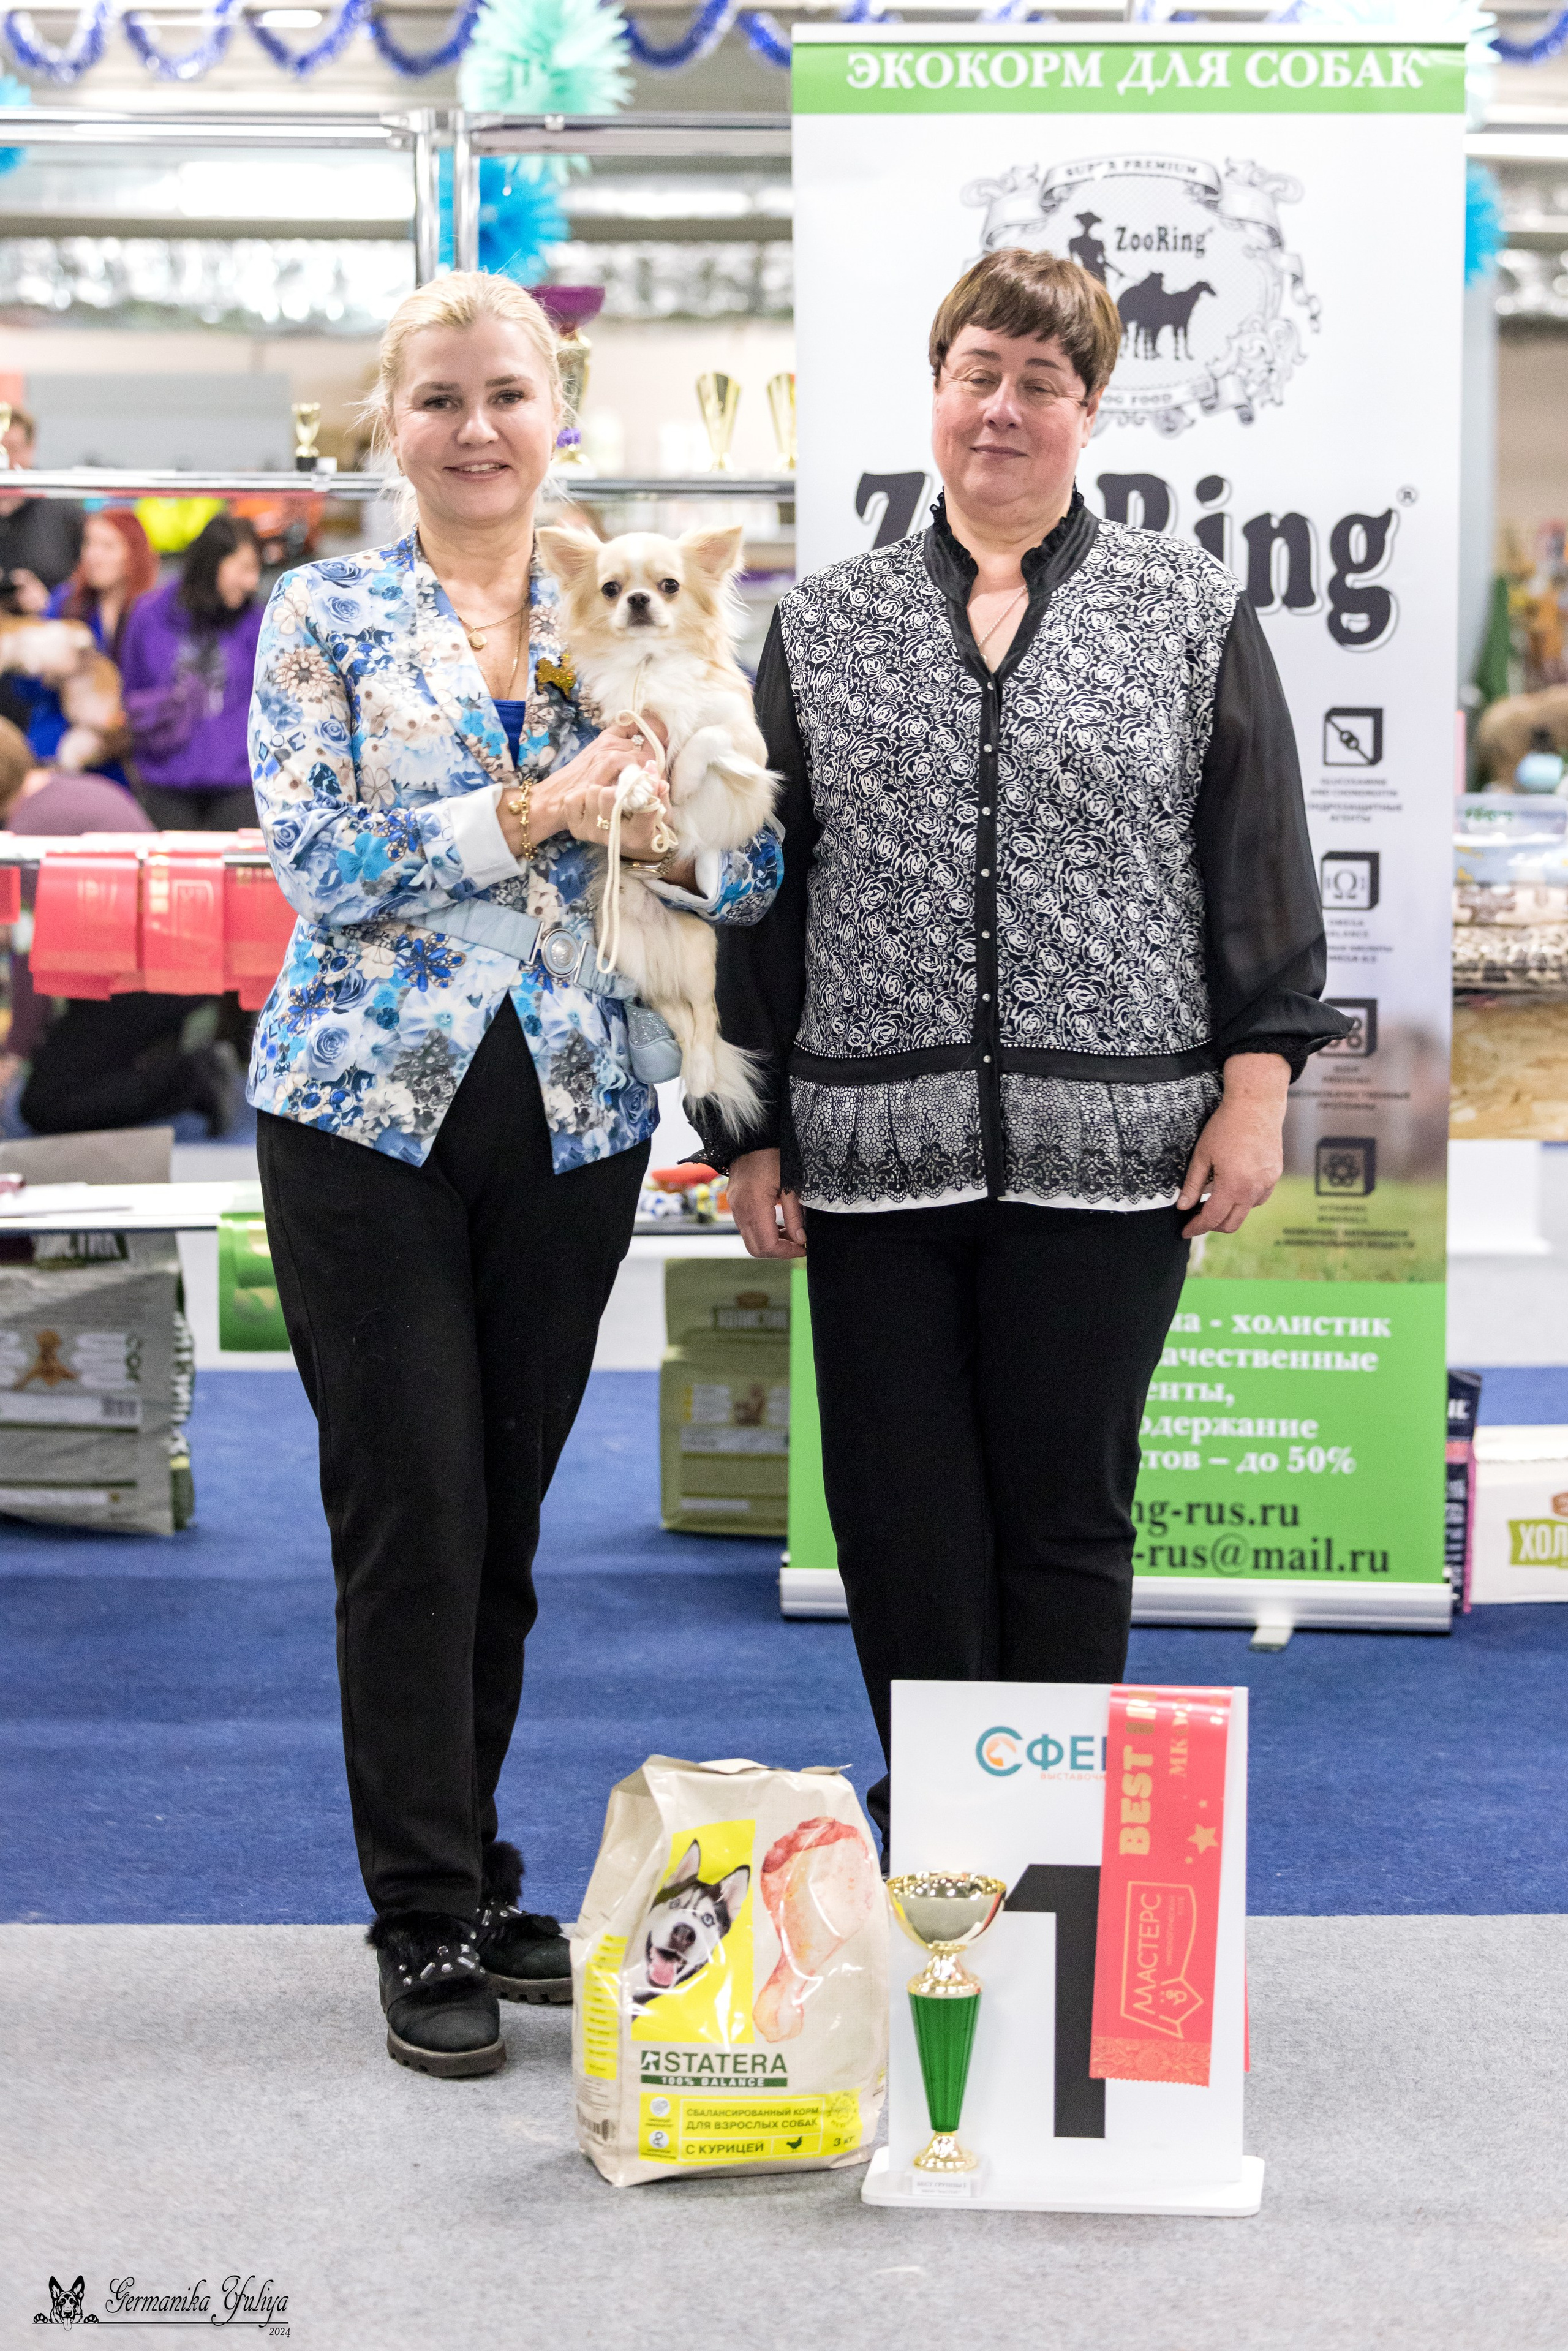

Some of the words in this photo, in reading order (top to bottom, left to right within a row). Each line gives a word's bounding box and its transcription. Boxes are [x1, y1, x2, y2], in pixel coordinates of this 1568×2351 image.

[846, 51, 1104, 89] ЭКОКОРМ
[1117, 51, 1231, 94] ДЛЯ
[1246, 51, 1424, 88] СОБАК
[1124, 160, 1197, 175] PREMIUM
[1115, 225, 1206, 259] ZooRing
[1231, 1314, 1391, 1338] холистик
[1159, 1347, 1378, 1372] ачественные
[1139, 1450, 1200, 1470] тов
[1236, 1452, 1280, 1474] до
[1287, 1445, 1357, 1475] 50%
[976, 1726, 1107, 1777] СФЕ
[1119, 1745, 1153, 1855] BEST
[1133, 1893, 1161, 2015] МАСТЕРС
[1002, 1863, 1106, 2138] 1
[665, 2052, 787, 2074] STATERA
[662, 2077, 694, 2086] 100%
[701, 2077, 765, 2087] BALANCE
[686, 2121, 710, 2130] ДЛЯ
[714, 2119, 778, 2129] ВЗРОСЛЫХ
[782, 2119, 818, 2128] СОБАК
[699, 2142, 764, 2155] КУРИЦЕЙ
